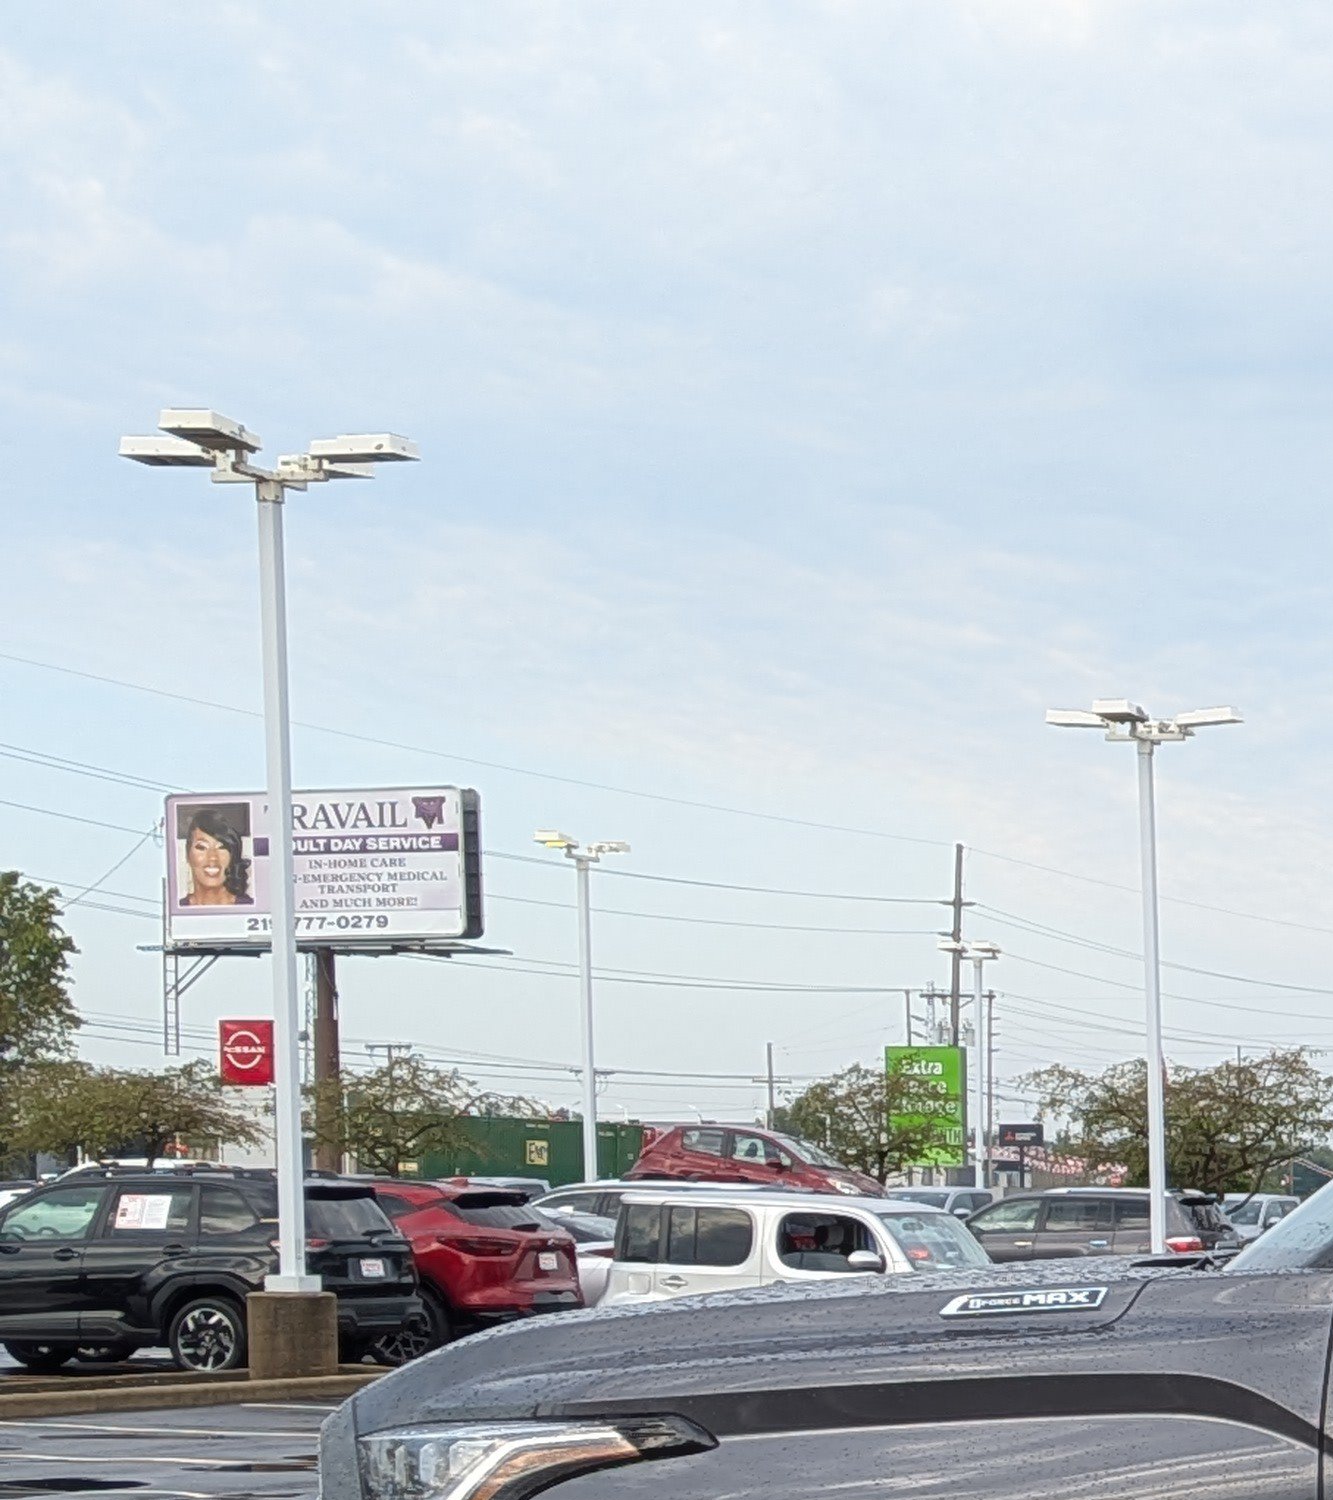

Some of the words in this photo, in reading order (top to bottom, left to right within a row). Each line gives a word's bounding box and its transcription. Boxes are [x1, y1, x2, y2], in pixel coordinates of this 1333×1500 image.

[264, 801, 408, 831] RAVAIL
[330, 837, 363, 852] DAY
[365, 836, 442, 851] SERVICE
[308, 858, 367, 869] IN-HOME
[370, 857, 406, 868] CARE
[387, 870, 448, 881] MEDICAL
[318, 883, 398, 894] TRANSPORT
[300, 898, 329, 909] AND
[332, 897, 372, 908] MUCH
[1022, 1291, 1090, 1305] MAX
